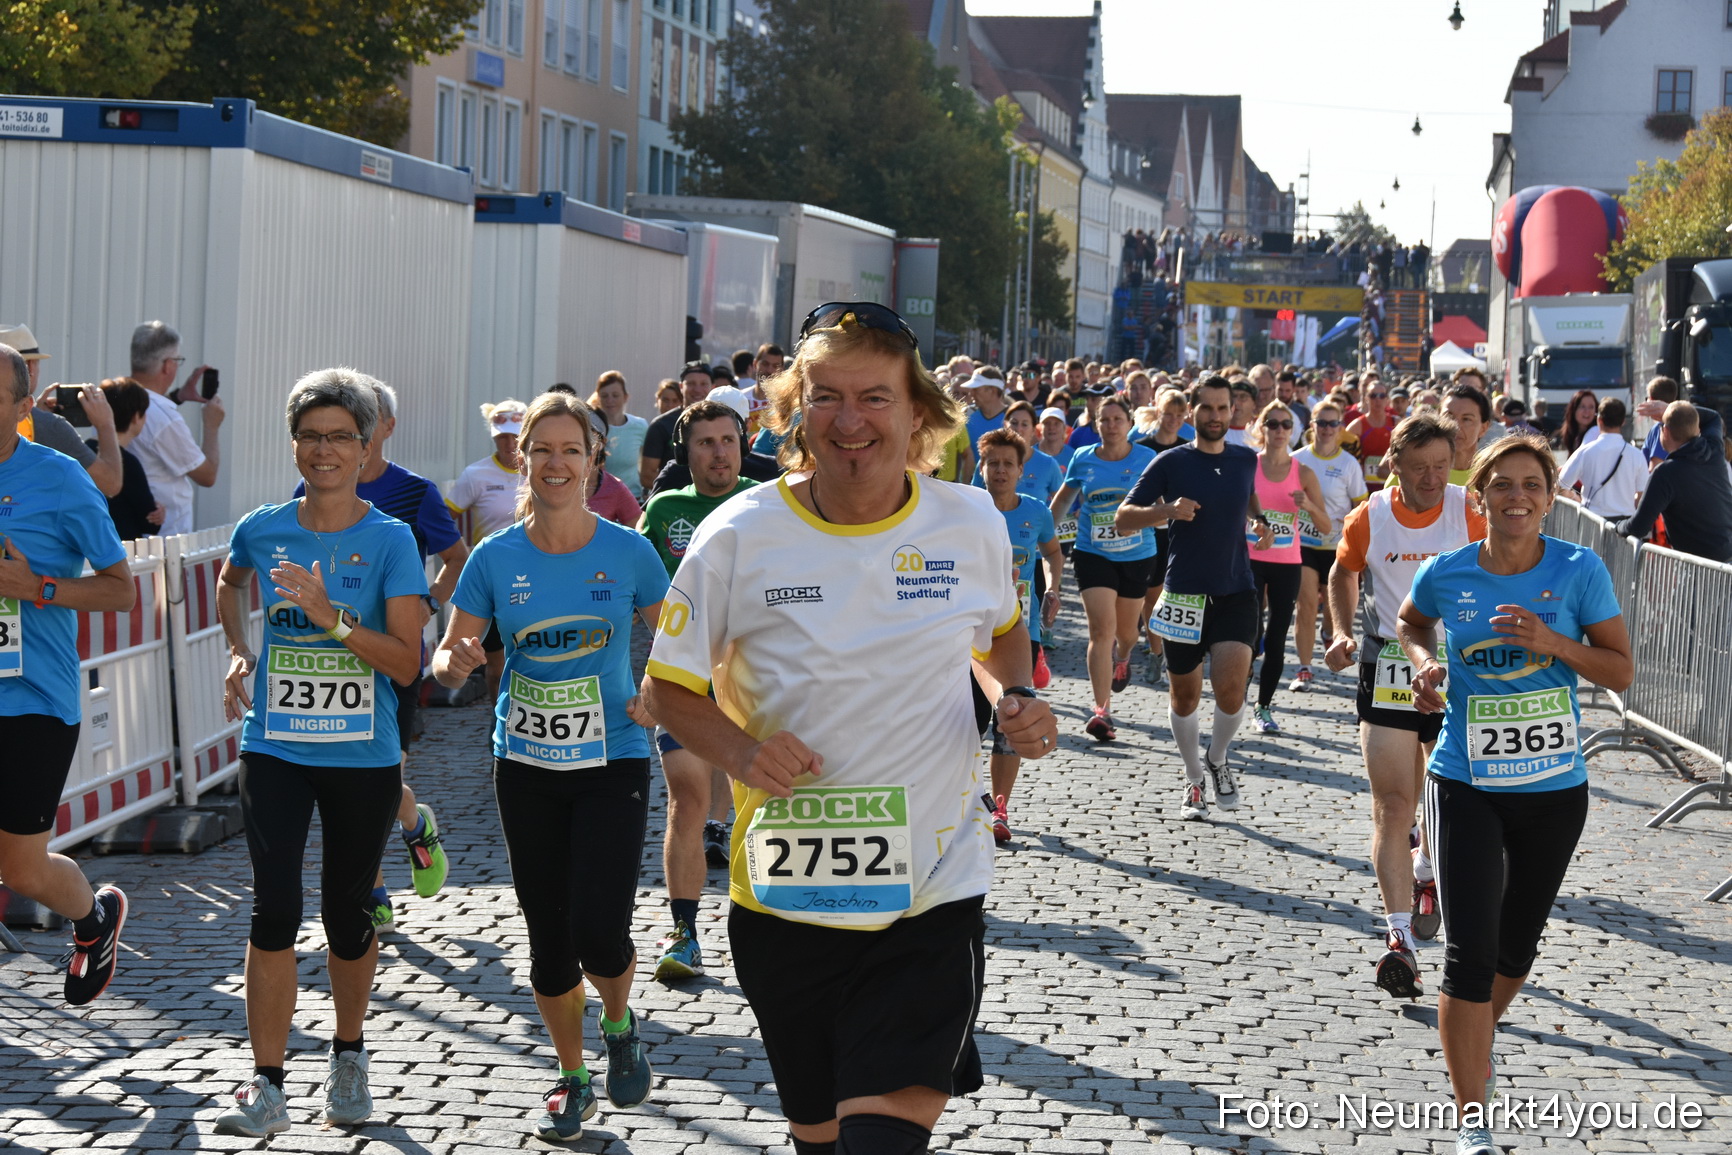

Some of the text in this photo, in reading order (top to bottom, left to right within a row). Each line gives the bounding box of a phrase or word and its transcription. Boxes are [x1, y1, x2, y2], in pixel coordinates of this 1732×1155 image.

[1243, 288, 1304, 305] START
[1094, 514, 1115, 523] BO
[1263, 510, 1293, 521] OCK
[1098, 527, 1124, 539] 23
[896, 553, 954, 572] 20 JAHRE
[896, 573, 960, 586] Neumarkter
[765, 586, 822, 602] BOCK
[897, 588, 951, 601] Stadtlauf
[511, 627, 613, 651] LAUF10!
[276, 650, 361, 673] BOCK
[278, 679, 362, 710] 2370
[515, 679, 589, 704] BOCK
[1391, 691, 1412, 702] RAI
[1477, 695, 1561, 717] BOCK
[289, 717, 347, 731] INGRID
[514, 706, 591, 740] 2367
[1480, 721, 1565, 756] 2363
[525, 743, 582, 760] NICOLE
[1487, 755, 1560, 775] BRIGITTE
[763, 791, 891, 822] BOCK
[765, 835, 892, 878] 2752
[793, 891, 878, 909] Joachim
